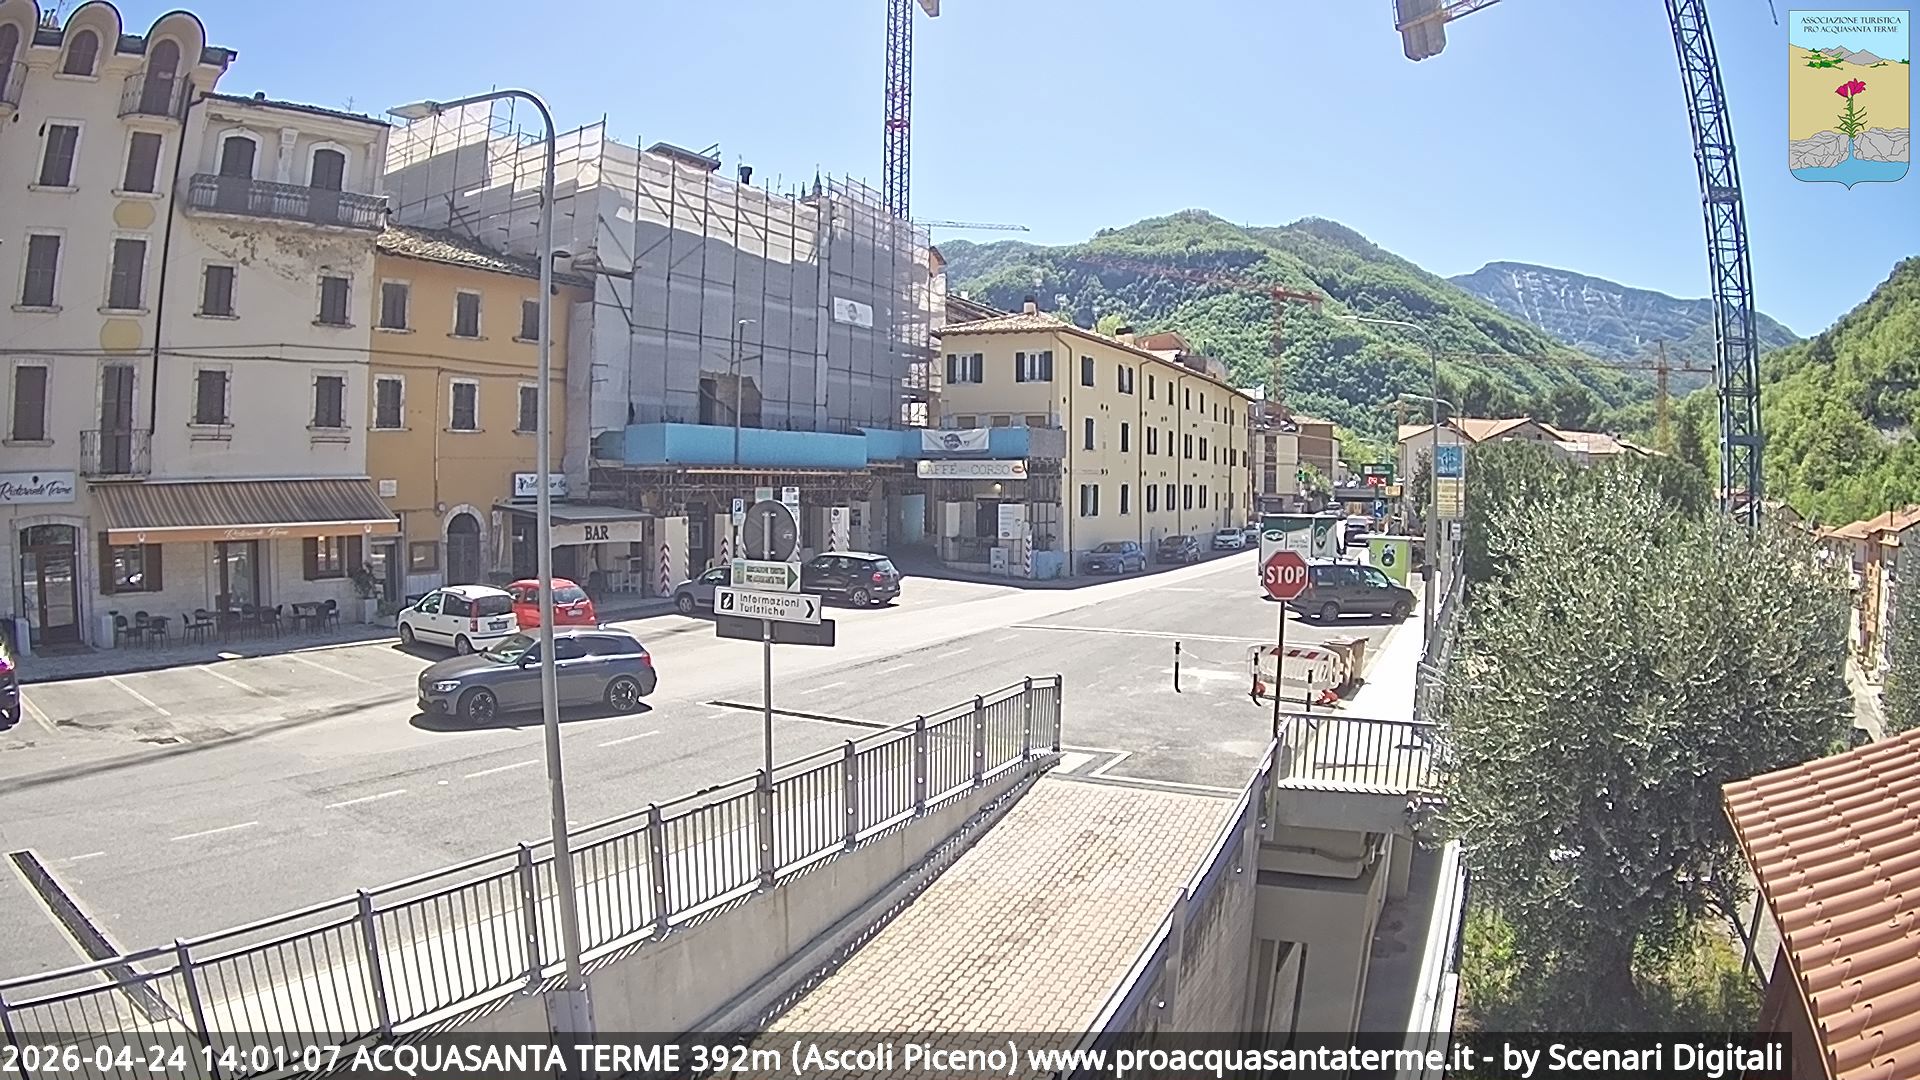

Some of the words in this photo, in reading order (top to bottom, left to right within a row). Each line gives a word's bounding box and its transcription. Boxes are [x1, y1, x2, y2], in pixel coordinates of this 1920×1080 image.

[971, 464, 1010, 475] CORSO
[1375, 501, 1382, 510] P
[584, 525, 609, 540] BAR
[1266, 566, 1305, 585] STOP
[740, 593, 799, 607] Informazioni
[740, 603, 785, 616] Turistiche
